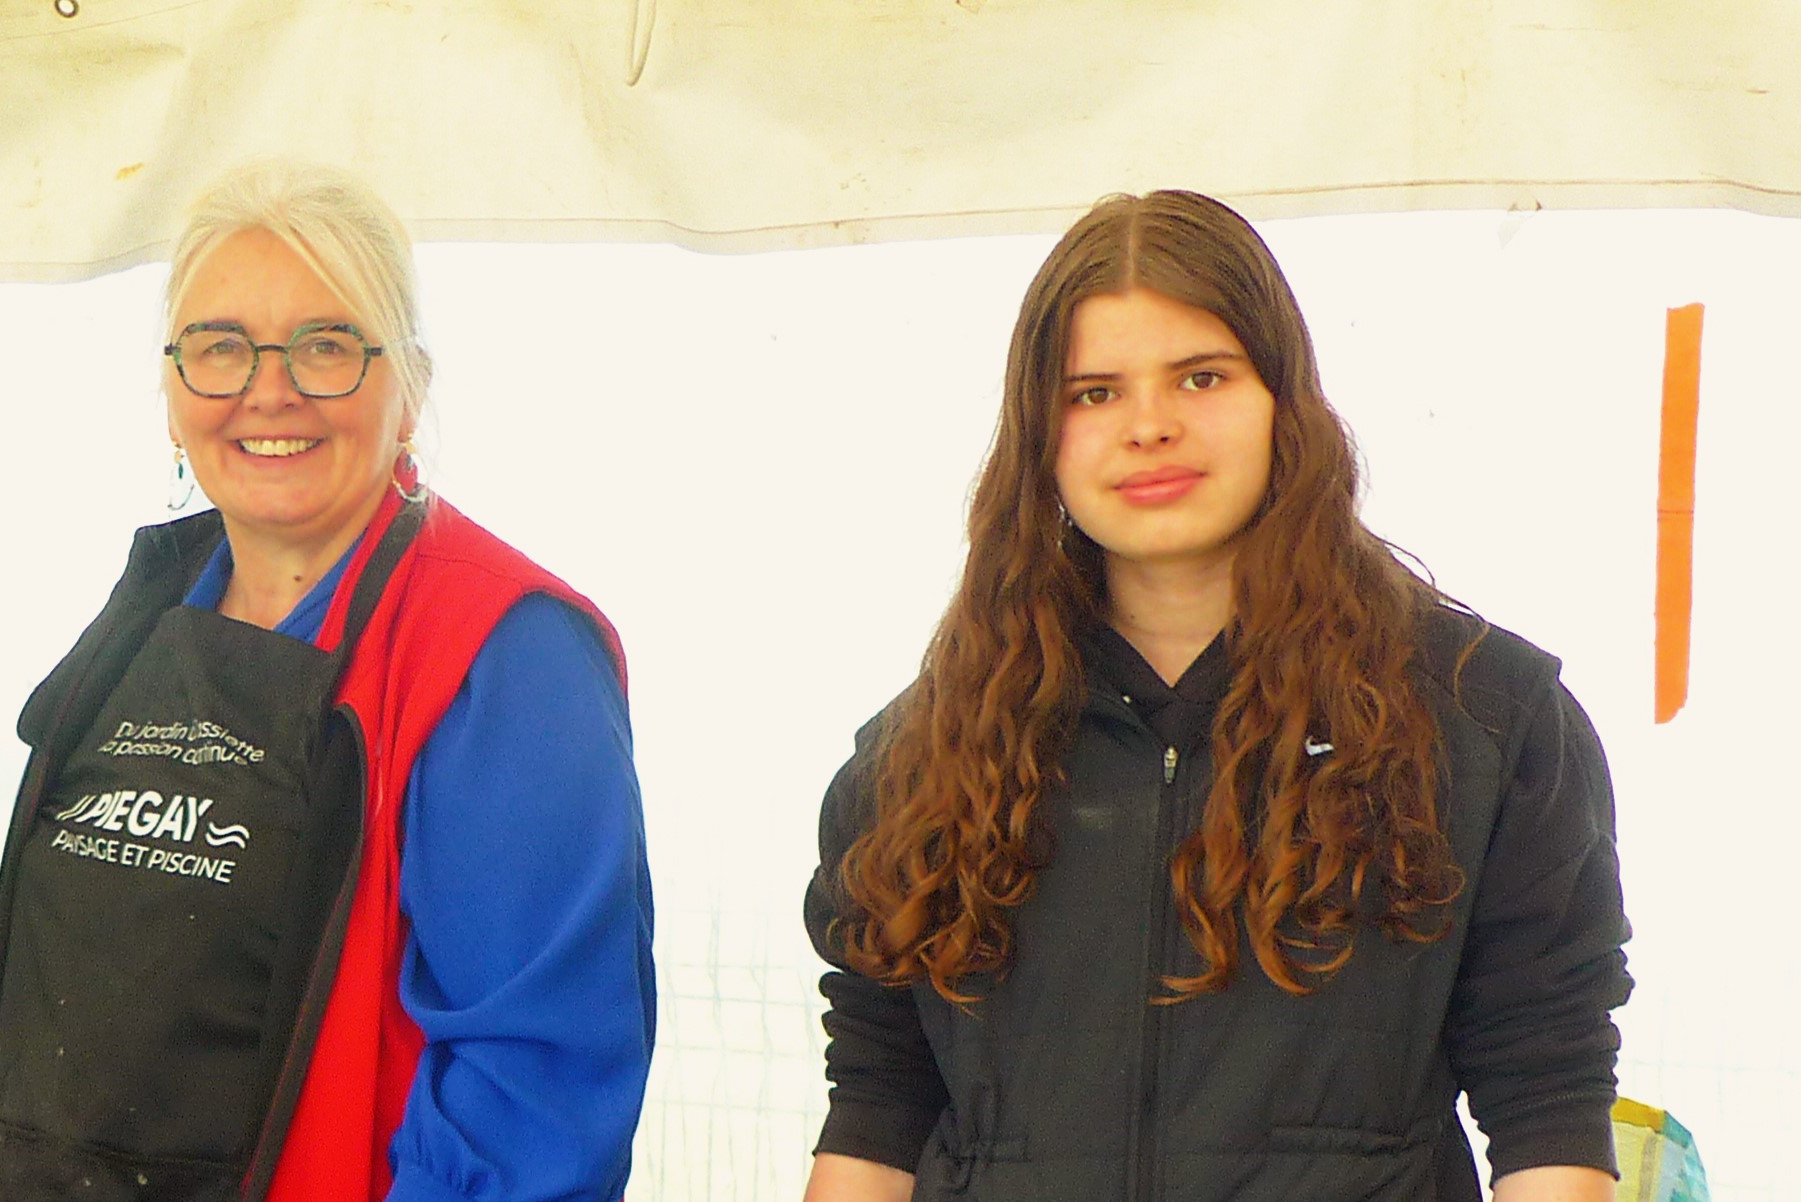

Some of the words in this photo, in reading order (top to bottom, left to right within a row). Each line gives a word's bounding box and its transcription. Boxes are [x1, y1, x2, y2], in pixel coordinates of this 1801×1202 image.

[51, 829, 119, 863] PAYSAGE
[120, 842, 150, 867] ET
[147, 849, 236, 884] PISCINE
